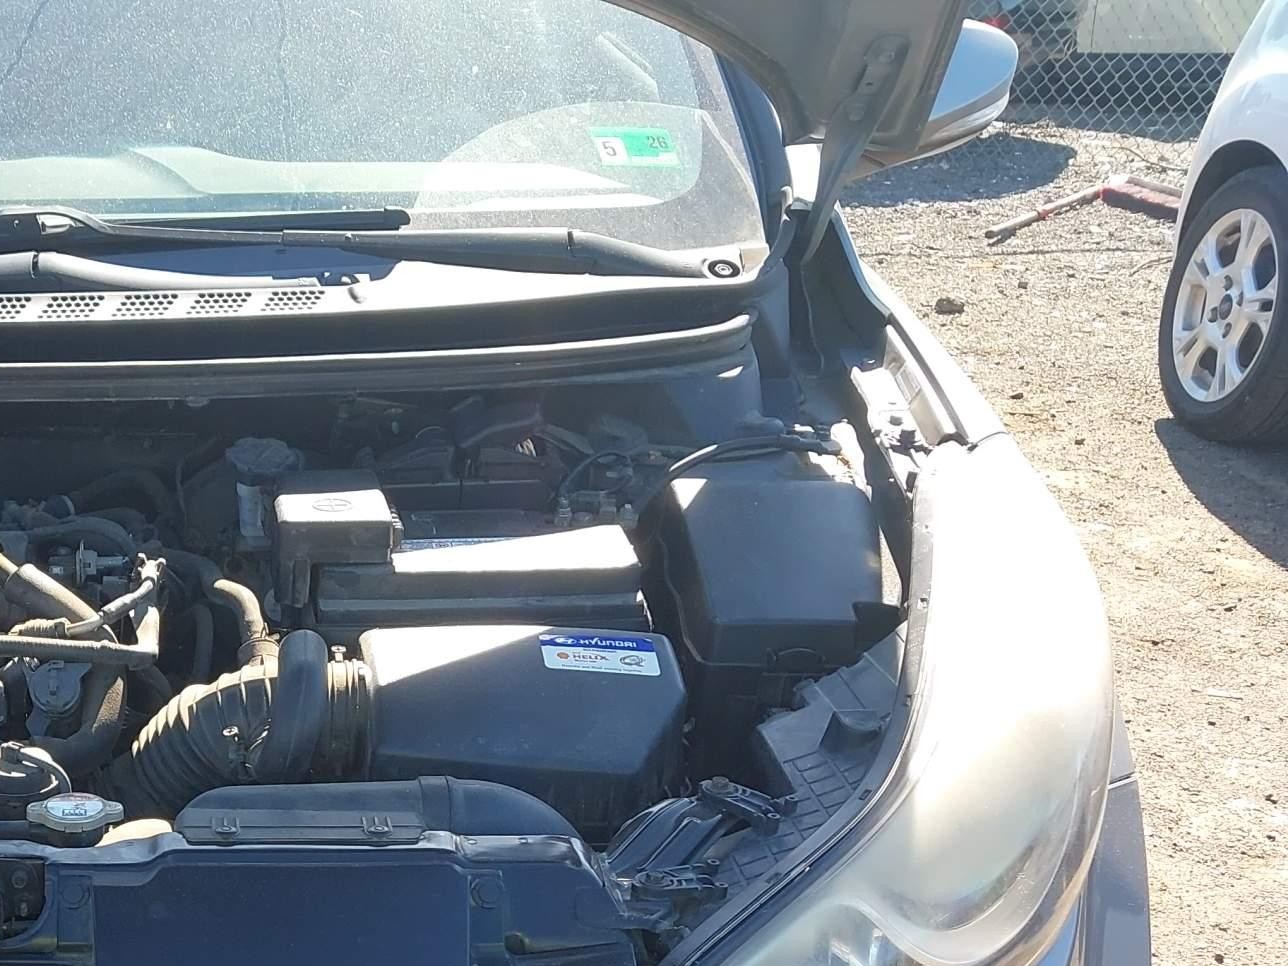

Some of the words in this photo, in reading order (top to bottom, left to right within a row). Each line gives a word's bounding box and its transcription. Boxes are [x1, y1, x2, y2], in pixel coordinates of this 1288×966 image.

[645, 135, 669, 149] 26
[601, 140, 617, 157] 5
[578, 637, 637, 648] HYUNDAI
[572, 653, 609, 662] HELIX
